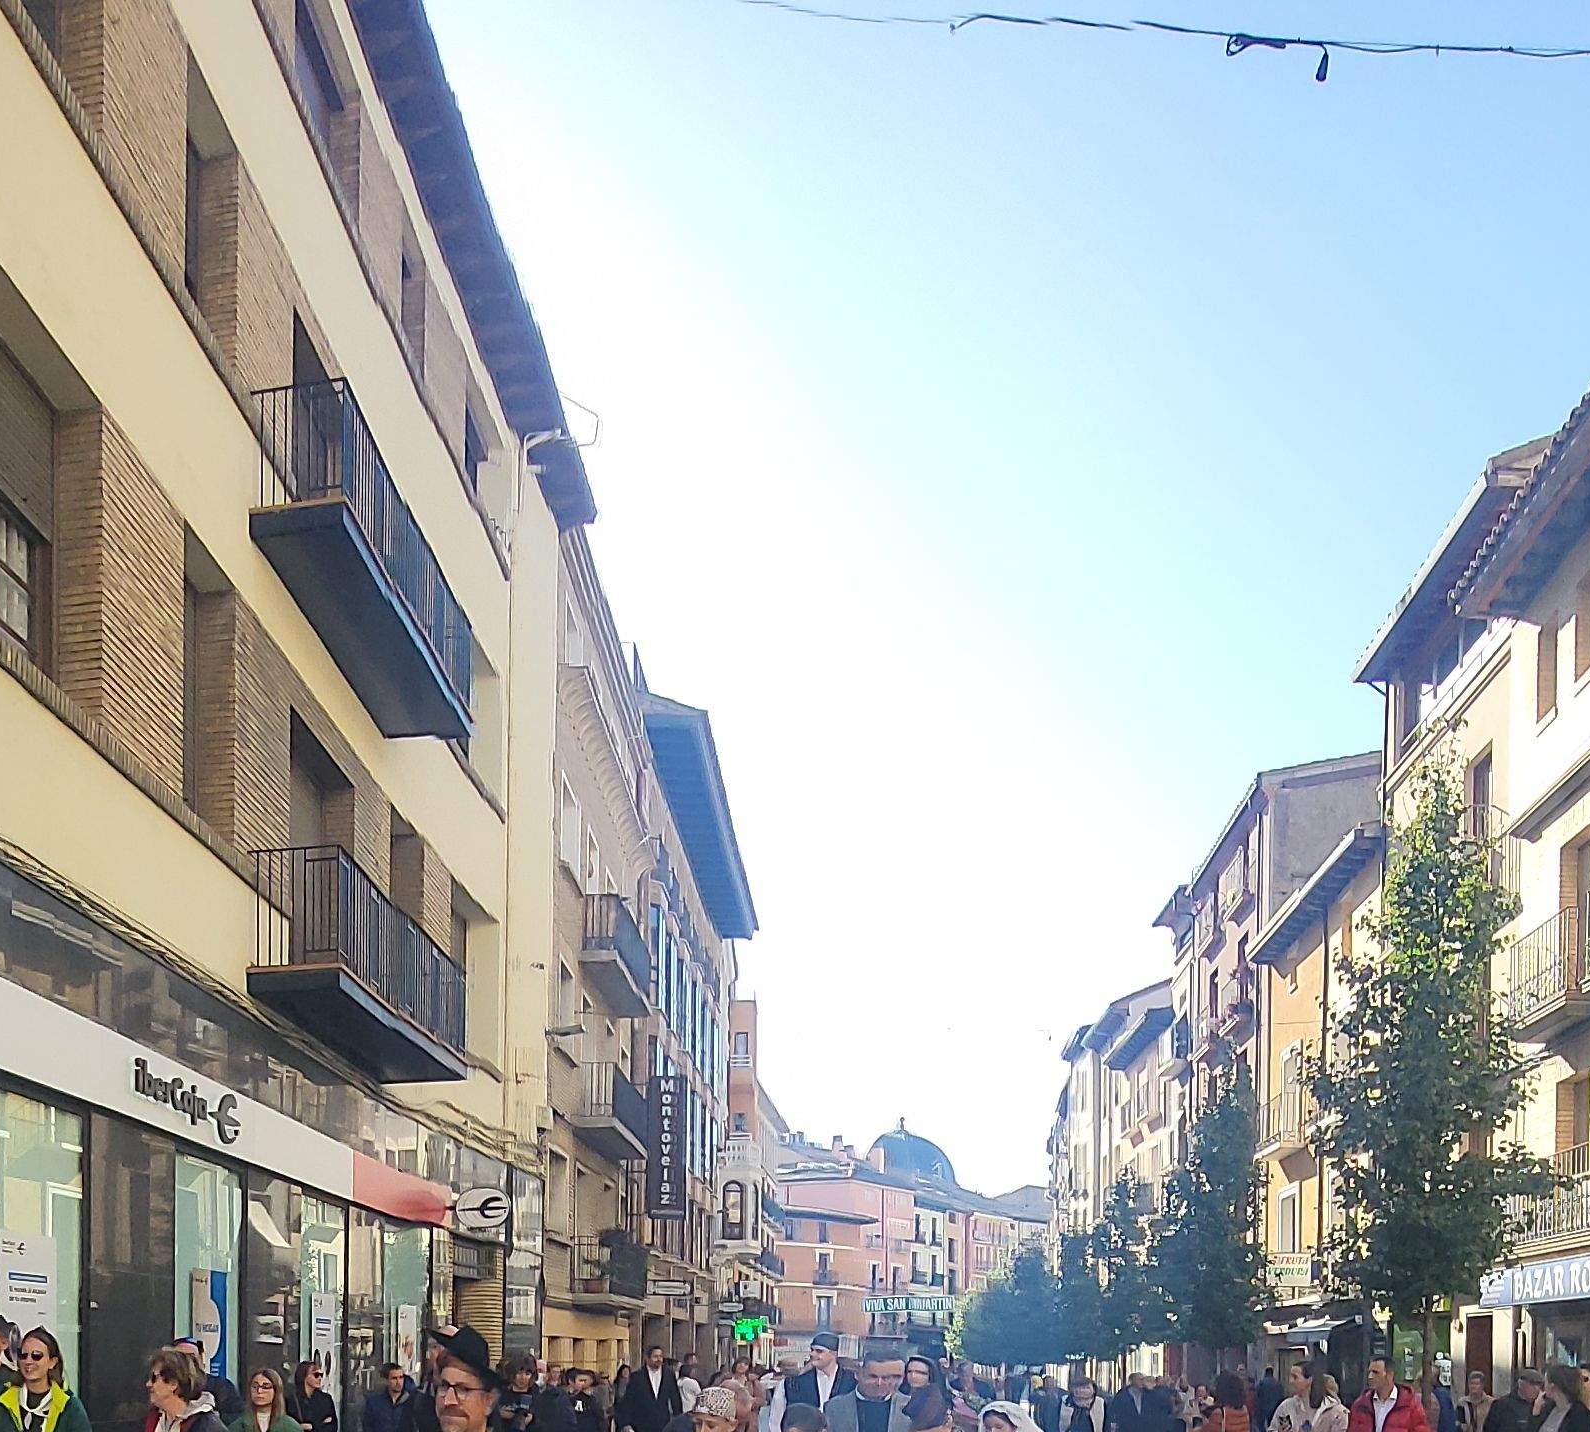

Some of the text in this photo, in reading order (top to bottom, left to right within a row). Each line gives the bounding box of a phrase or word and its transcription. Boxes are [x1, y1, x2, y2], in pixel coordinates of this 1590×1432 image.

[659, 1078, 674, 1205] Montovelaz
[1514, 1264, 1564, 1300] BAZAR
[865, 1298, 885, 1312] VIVA
[887, 1297, 907, 1310] SAN
